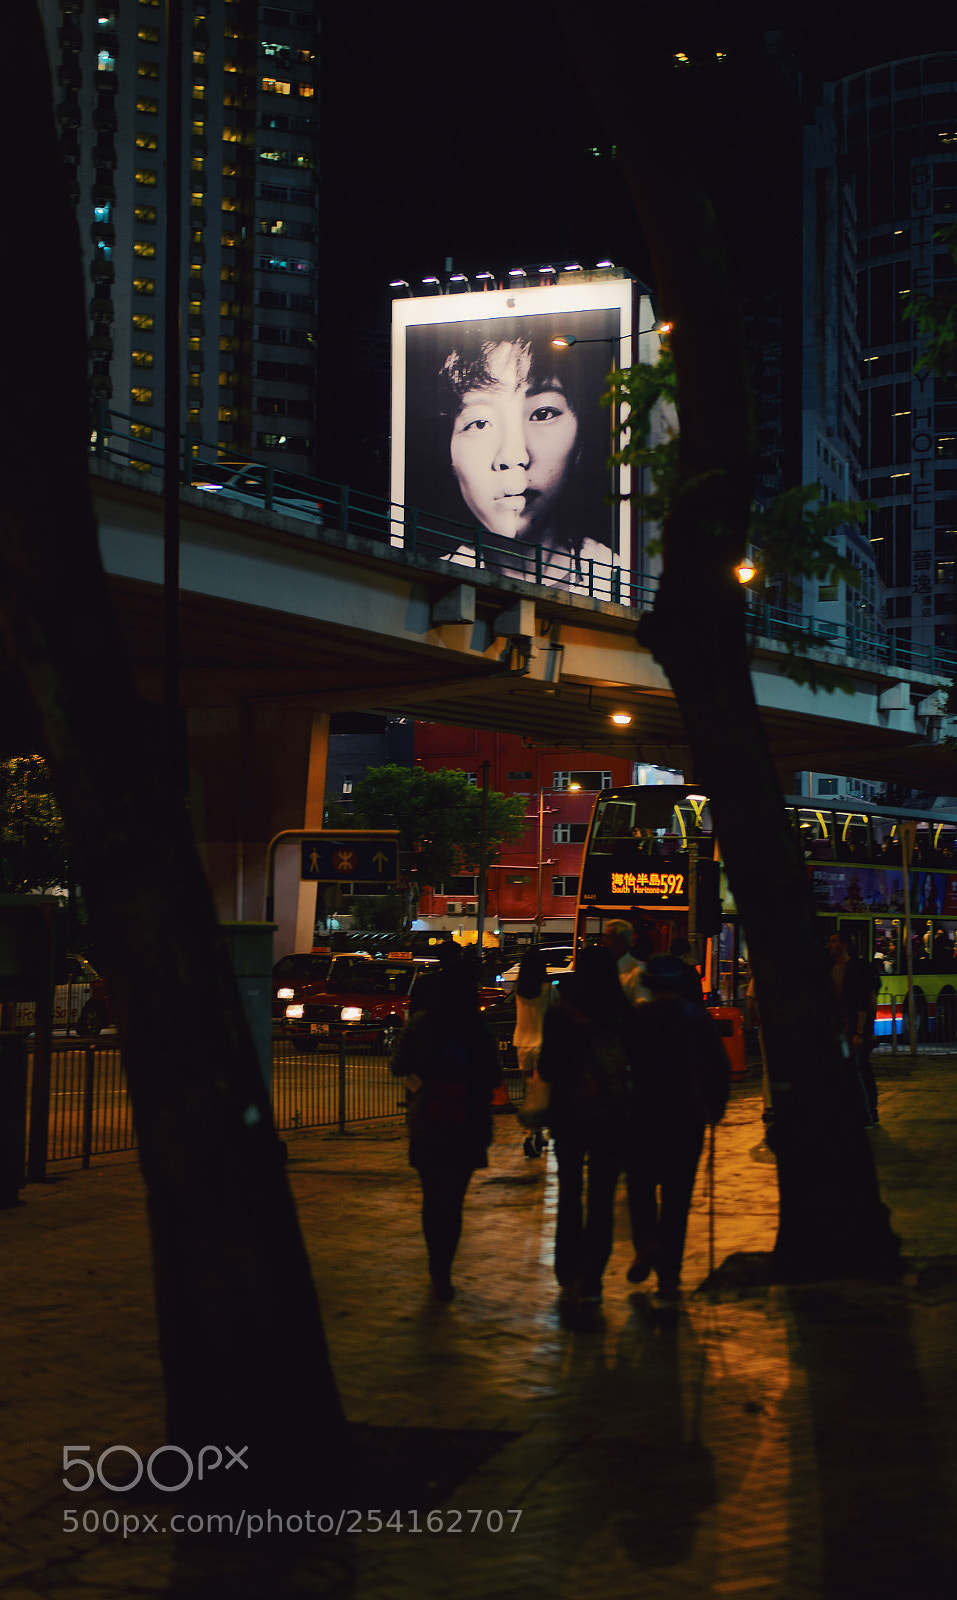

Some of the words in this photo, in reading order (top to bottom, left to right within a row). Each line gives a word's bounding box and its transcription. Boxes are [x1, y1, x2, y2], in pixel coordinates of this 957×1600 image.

[911, 165, 932, 393] BUTTEFLY
[912, 407, 933, 531] HOTEL
[611, 872, 660, 886] 海怡半島
[660, 873, 685, 894] 592
[611, 885, 631, 894] South
